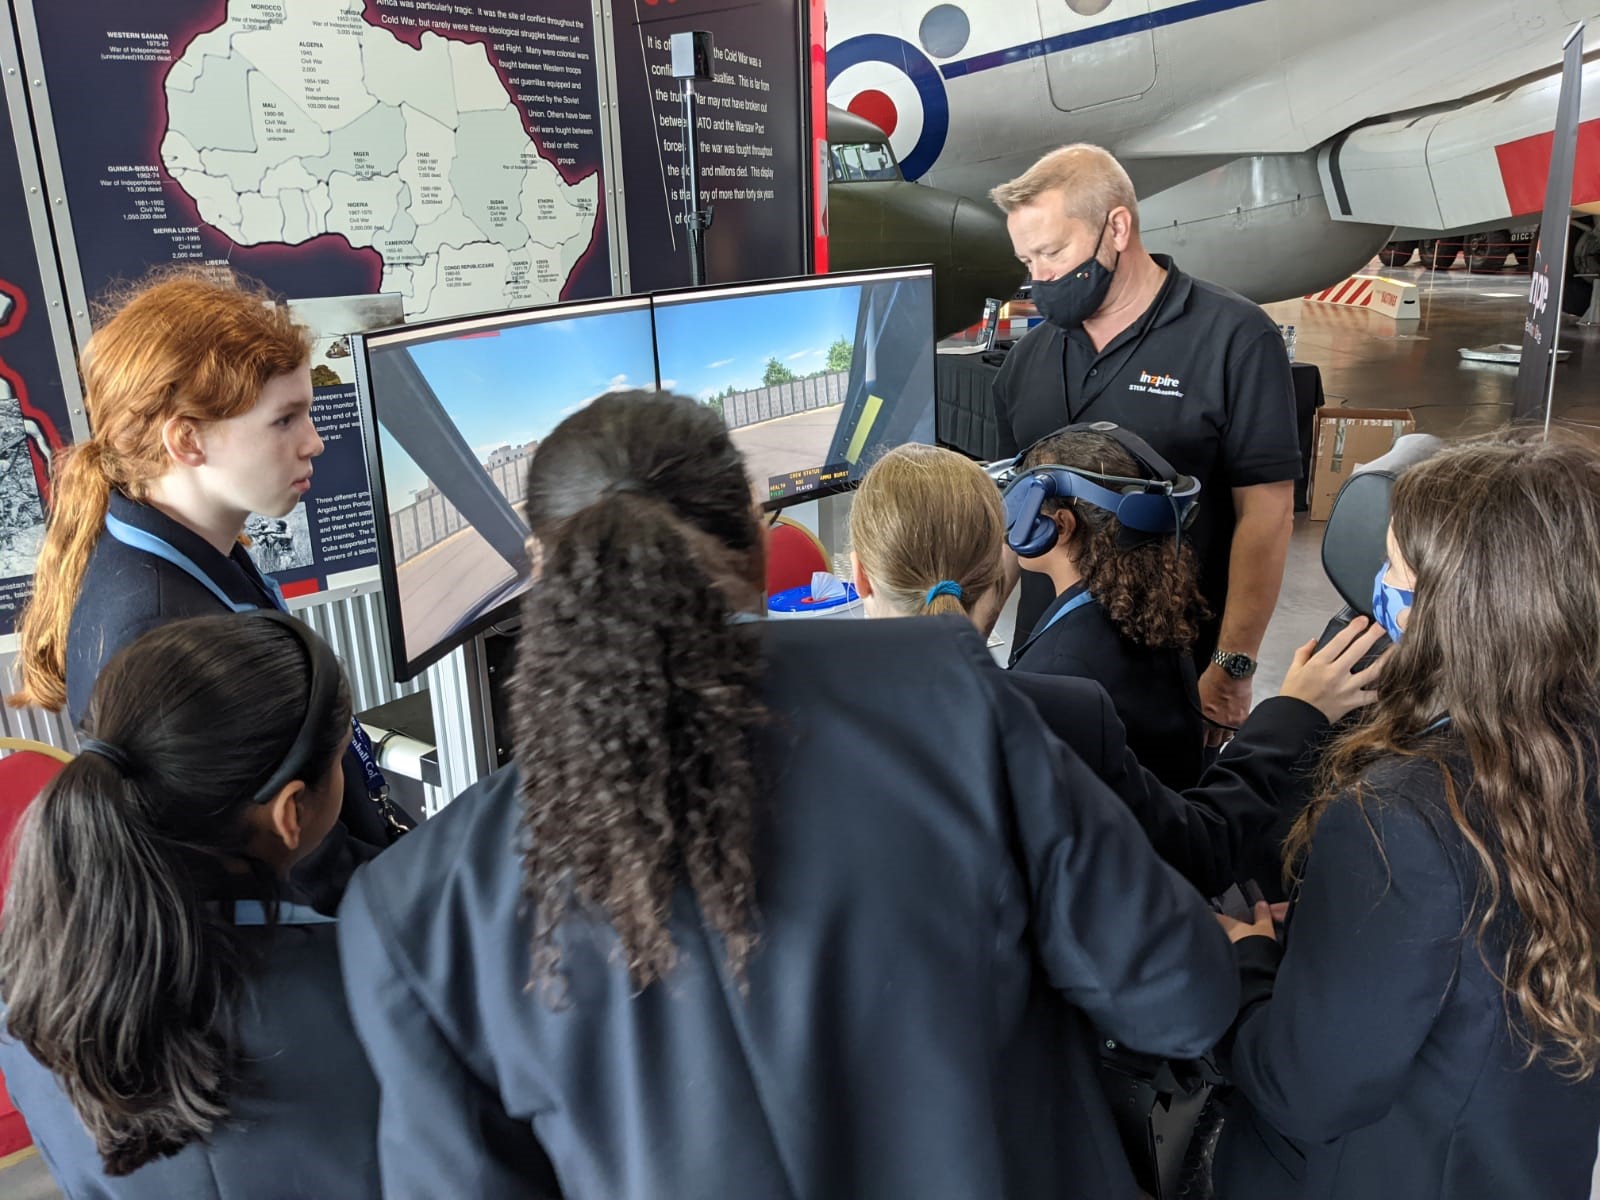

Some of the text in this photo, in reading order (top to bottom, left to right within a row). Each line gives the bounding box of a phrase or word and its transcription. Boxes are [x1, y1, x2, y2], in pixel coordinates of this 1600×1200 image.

[416, 2, 452, 13] particularly
[455, 6, 474, 15] tragic.
[497, 10, 506, 18] the
[508, 12, 518, 20] site
[527, 14, 546, 24] conflict
[547, 17, 574, 27] throughout
[381, 14, 398, 24] Cold
[400, 16, 417, 26] War,
[418, 18, 430, 26] but
[432, 20, 450, 30] rarely
[470, 24, 487, 32] these
[488, 25, 519, 36] ideological
[520, 30, 546, 40] struggles
[546, 32, 568, 42] between
[570, 36, 580, 44] Left
[506, 44, 522, 54] Right.
[526, 46, 541, 56] Many
[556, 50, 576, 58] colonial
[648, 35, 653, 48] It
[655, 36, 662, 50] is
[714, 47, 723, 60] the
[724, 48, 738, 62] Cold
[738, 51, 748, 64] War
[750, 56, 758, 67] was
[498, 59, 582, 74] fought between Western troops
[652, 64, 672, 76] confli
[738, 74, 749, 88] This
[520, 78, 546, 87] guerrillas
[546, 81, 570, 90] equipped
[518, 94, 545, 102] supported
[546, 95, 553, 104] by
[563, 96, 580, 104] Soviet
[656, 88, 668, 102] the
[708, 96, 720, 110] may
[722, 97, 730, 108] not
[732, 97, 744, 110] have
[745, 99, 760, 111] broken
[528, 110, 546, 118] Union.
[546, 110, 564, 118] Others
[555, 126, 572, 136] fought
[697, 117, 764, 134] ATO and the Warsaw Pact
[700, 141, 772, 158] the war was fought throughout
[668, 164, 679, 176] the
[702, 165, 714, 176] and
[714, 165, 736, 176] millions
[736, 166, 748, 176] died.
[751, 166, 760, 176] This
[760, 166, 774, 180] display
[672, 188, 678, 200] is
[712, 188, 718, 200] of
[719, 190, 733, 199] more
[734, 188, 745, 199] than
[746, 188, 756, 202] forty
[1140, 370, 1180, 387] inzpire
[334, 493, 356, 501] different
[339, 539, 367, 548] supported
[324, 554, 346, 562] winners
